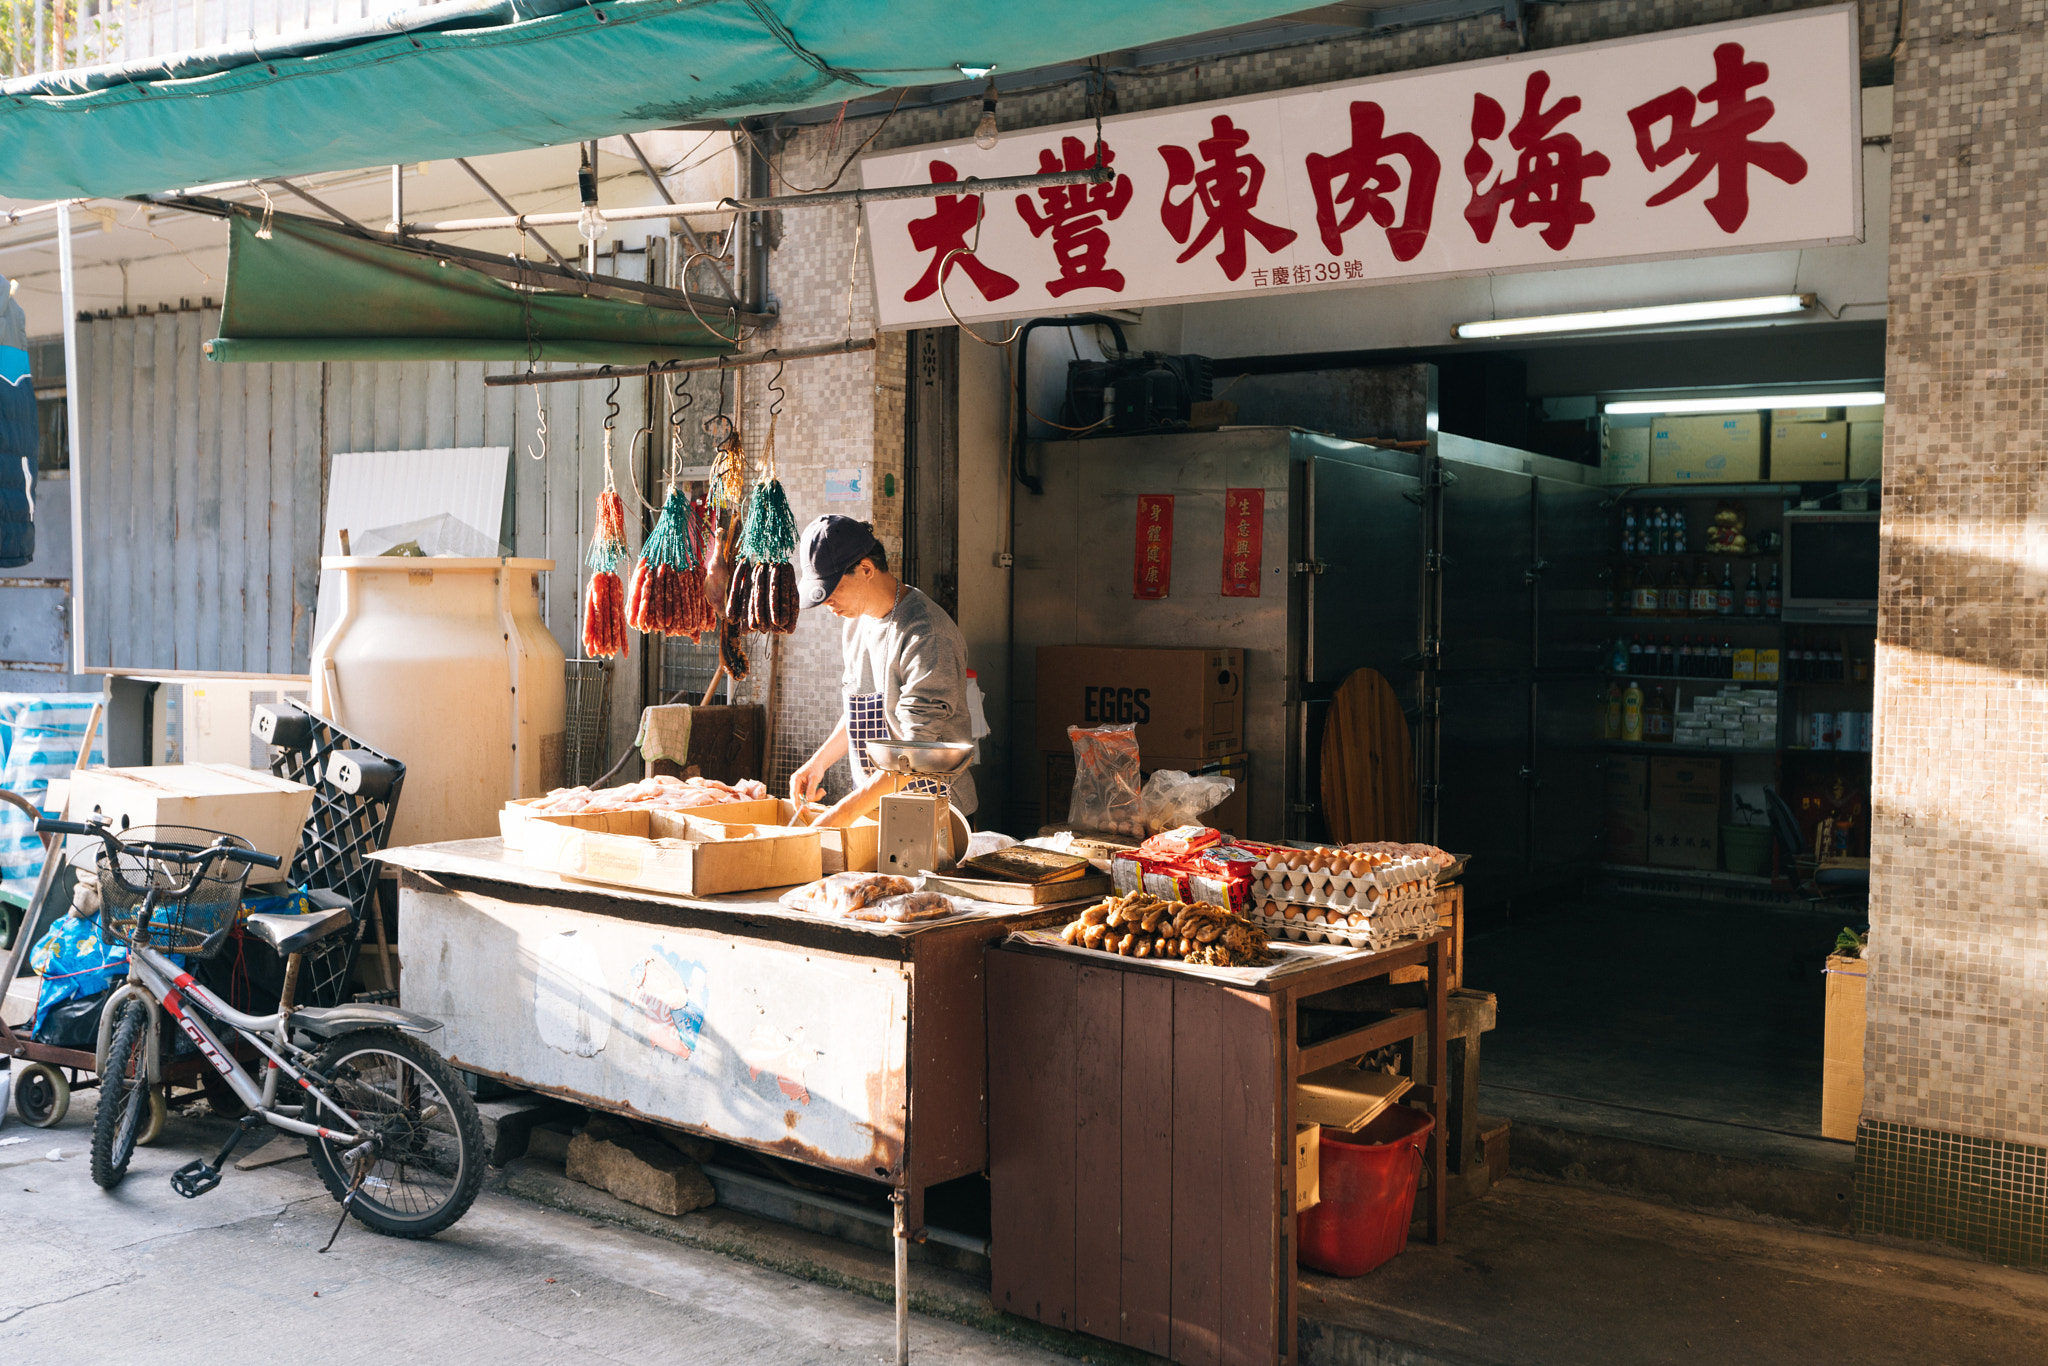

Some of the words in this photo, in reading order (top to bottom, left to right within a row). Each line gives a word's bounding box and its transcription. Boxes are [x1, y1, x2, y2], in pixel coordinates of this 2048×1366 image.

[904, 42, 1808, 302] 大豐凍肉海味
[1251, 259, 1364, 288] 吉慶街39號
[1145, 504, 1162, 584] 身體健康
[1234, 498, 1252, 580] 生意興隆
[1085, 686, 1151, 725] EGGS
[179, 1016, 234, 1075] GTA
